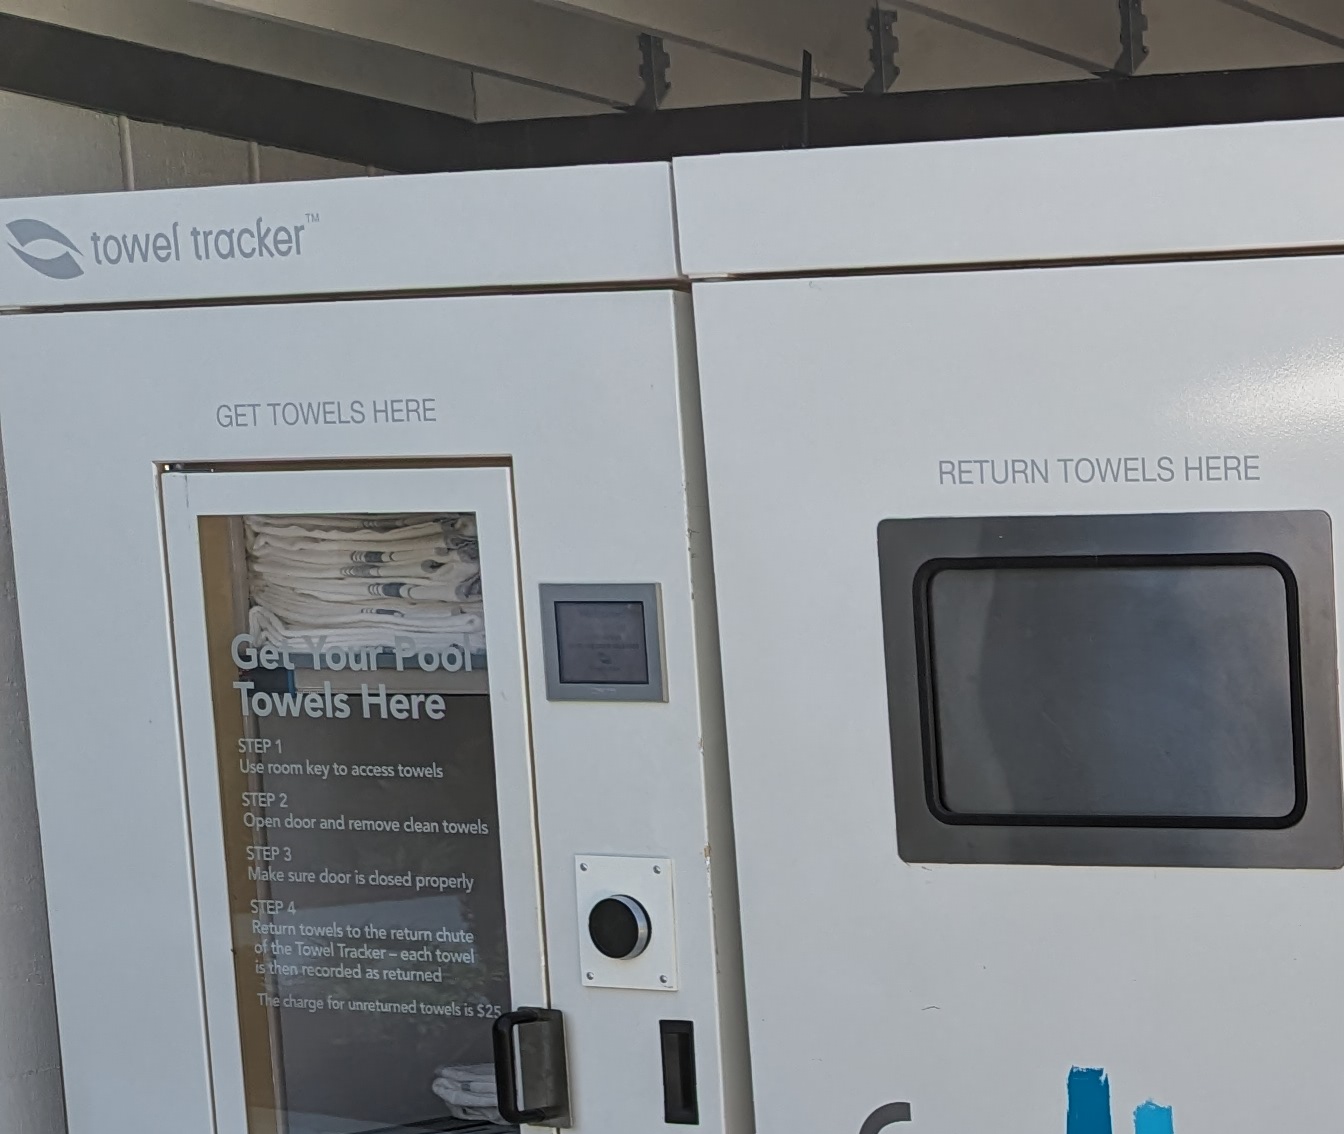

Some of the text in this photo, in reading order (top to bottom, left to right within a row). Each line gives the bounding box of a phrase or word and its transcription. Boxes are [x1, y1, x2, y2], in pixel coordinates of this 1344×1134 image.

[90, 222, 181, 266] towel
[216, 398, 437, 428] GET TOWELS HERE
[938, 455, 1261, 485] RETURN TOWELS HERE
[231, 633, 472, 672] Get Your Pool
[233, 681, 446, 719] Towels Here
[238, 738, 282, 754] STEP 1
[240, 759, 443, 779] Use room key to access towels
[241, 792, 288, 808] STEP 2
[243, 812, 489, 835] Open door and remove clean towels
[246, 846, 292, 861] STEP 3
[247, 866, 474, 893] Make sure door is closed properly
[250, 900, 296, 915] STEP 4
[252, 920, 474, 943] Return towels to the return chute
[254, 941, 267, 954] of
[270, 941, 292, 956] the
[295, 942, 335, 957] Towel
[337, 943, 386, 960] Tracker
[400, 947, 432, 963] each
[435, 949, 475, 964] towel
[255, 960, 442, 983] is then recorded as returned
[256, 992, 501, 1019] The charge for unreturned towels is $25
